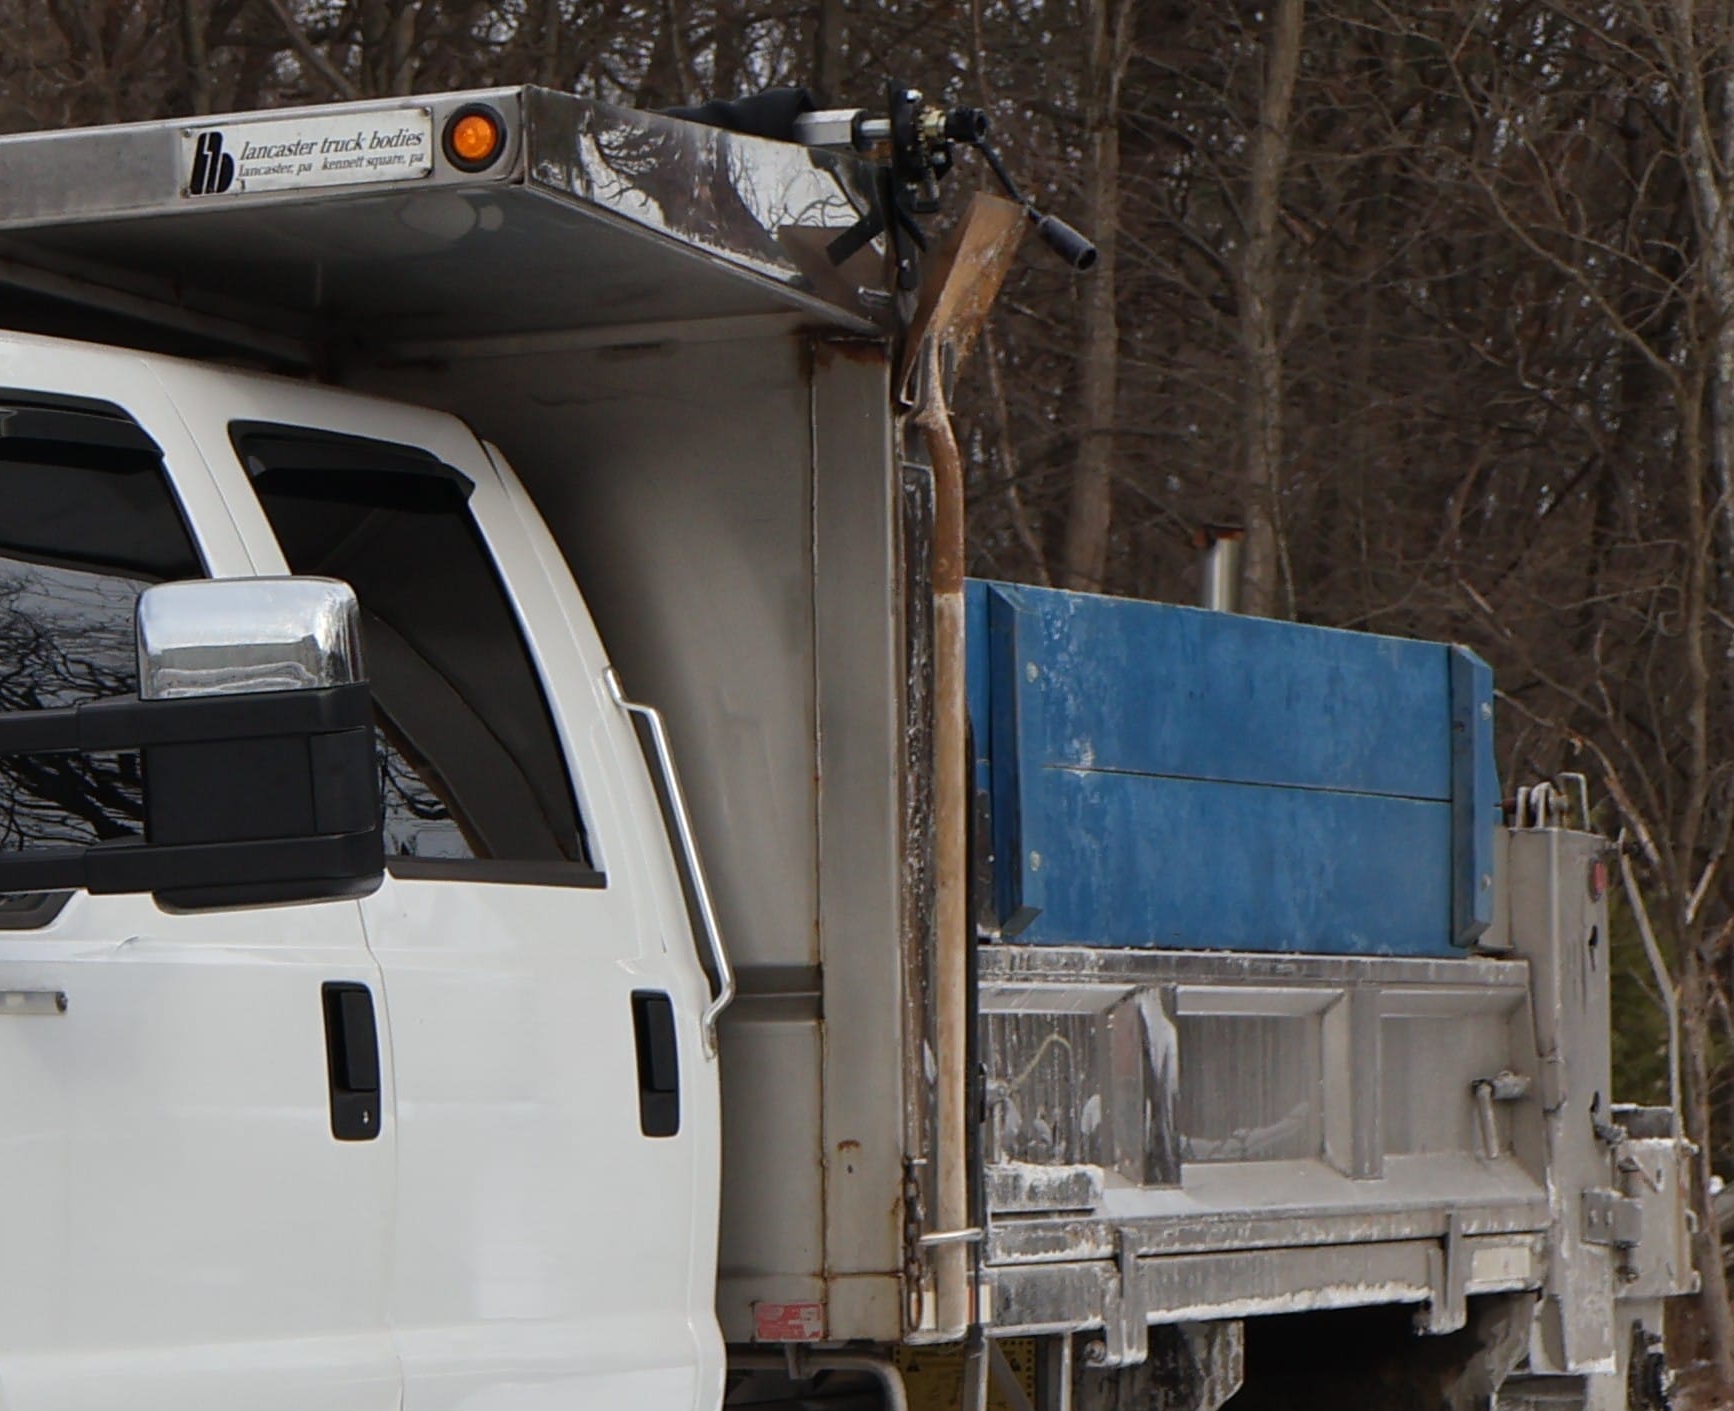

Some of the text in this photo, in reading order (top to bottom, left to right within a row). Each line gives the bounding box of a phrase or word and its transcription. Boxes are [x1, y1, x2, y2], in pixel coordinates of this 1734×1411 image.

[240, 128, 424, 160] lancaster truck bodies
[238, 163, 294, 177] lancaster,
[296, 162, 312, 176] pa
[409, 153, 424, 167] pa
